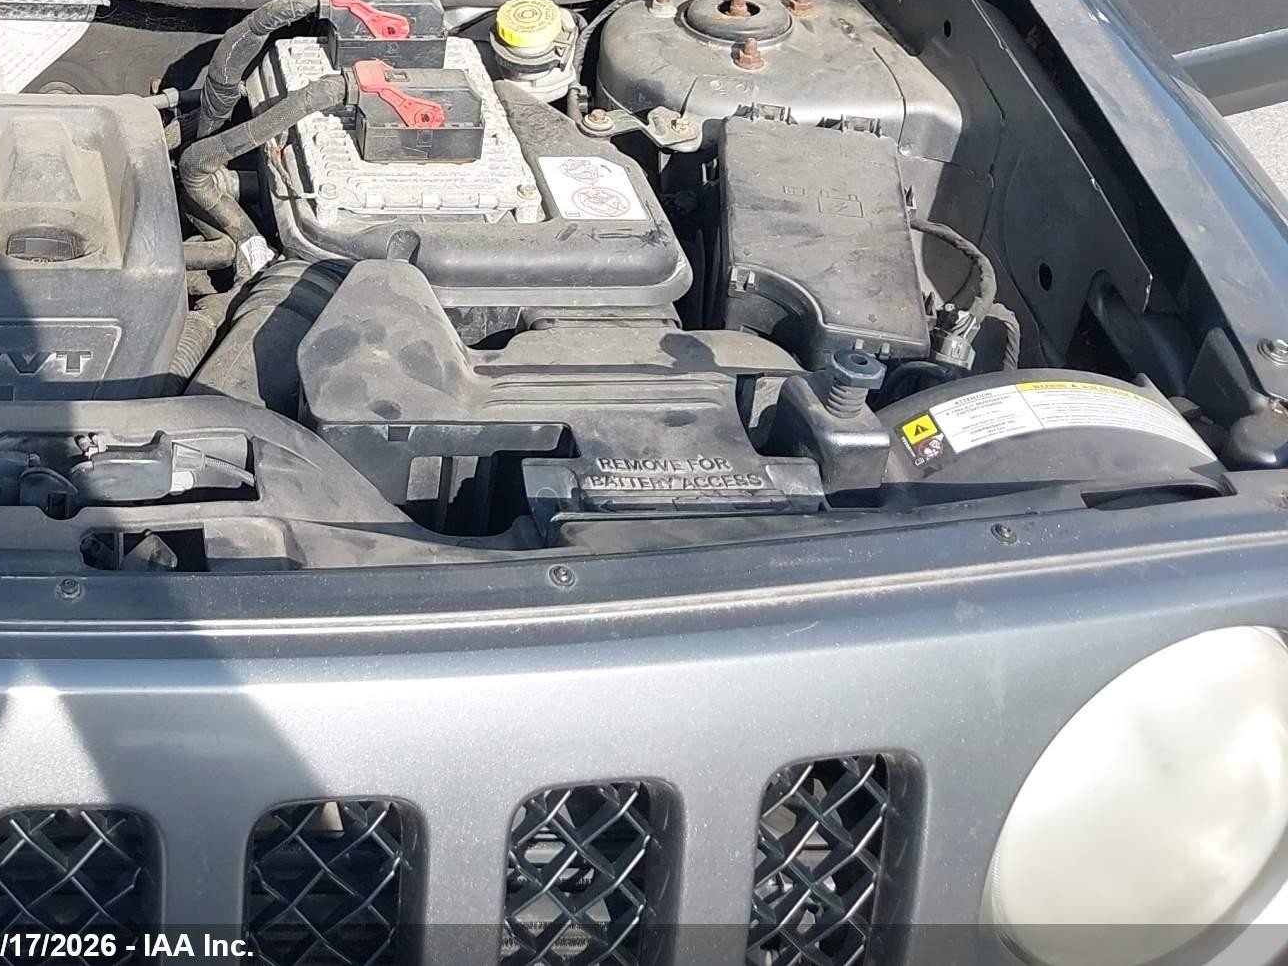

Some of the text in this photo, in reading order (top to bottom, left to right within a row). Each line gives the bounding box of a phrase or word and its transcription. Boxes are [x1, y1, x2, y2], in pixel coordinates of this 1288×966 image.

[596, 457, 732, 472] REMOVE FOR
[588, 472, 763, 490] BATTERY ACCESS
